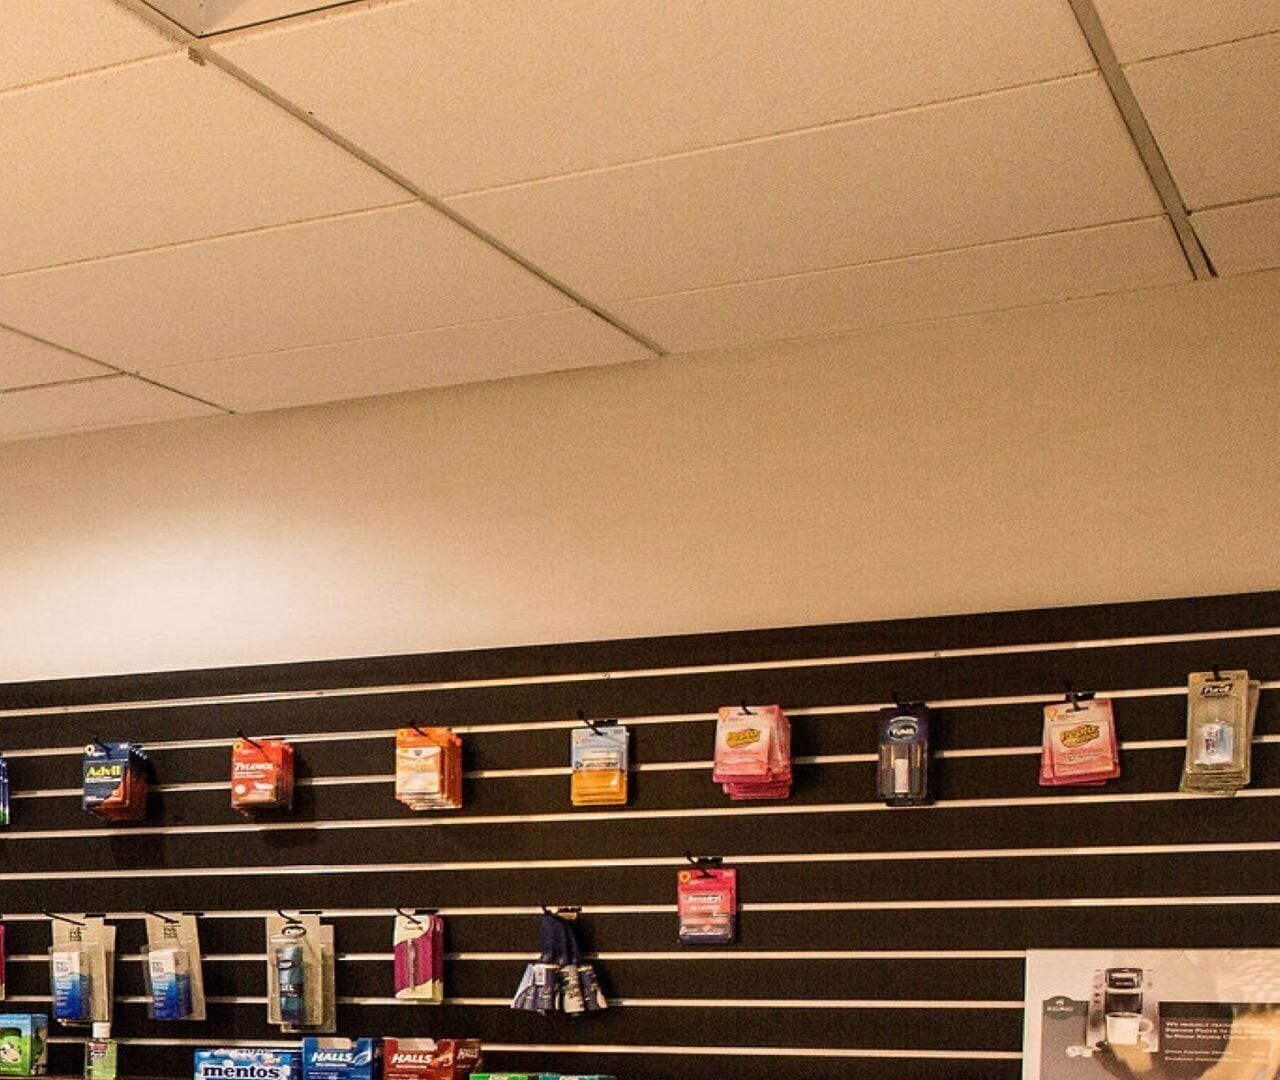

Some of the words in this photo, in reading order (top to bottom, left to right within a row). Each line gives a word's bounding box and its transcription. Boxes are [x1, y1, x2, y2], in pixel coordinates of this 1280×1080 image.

[87, 765, 122, 777] Advil
[311, 1051, 353, 1063] HALLS
[392, 1053, 433, 1064] HALLS
[202, 1064, 281, 1079] mentos
